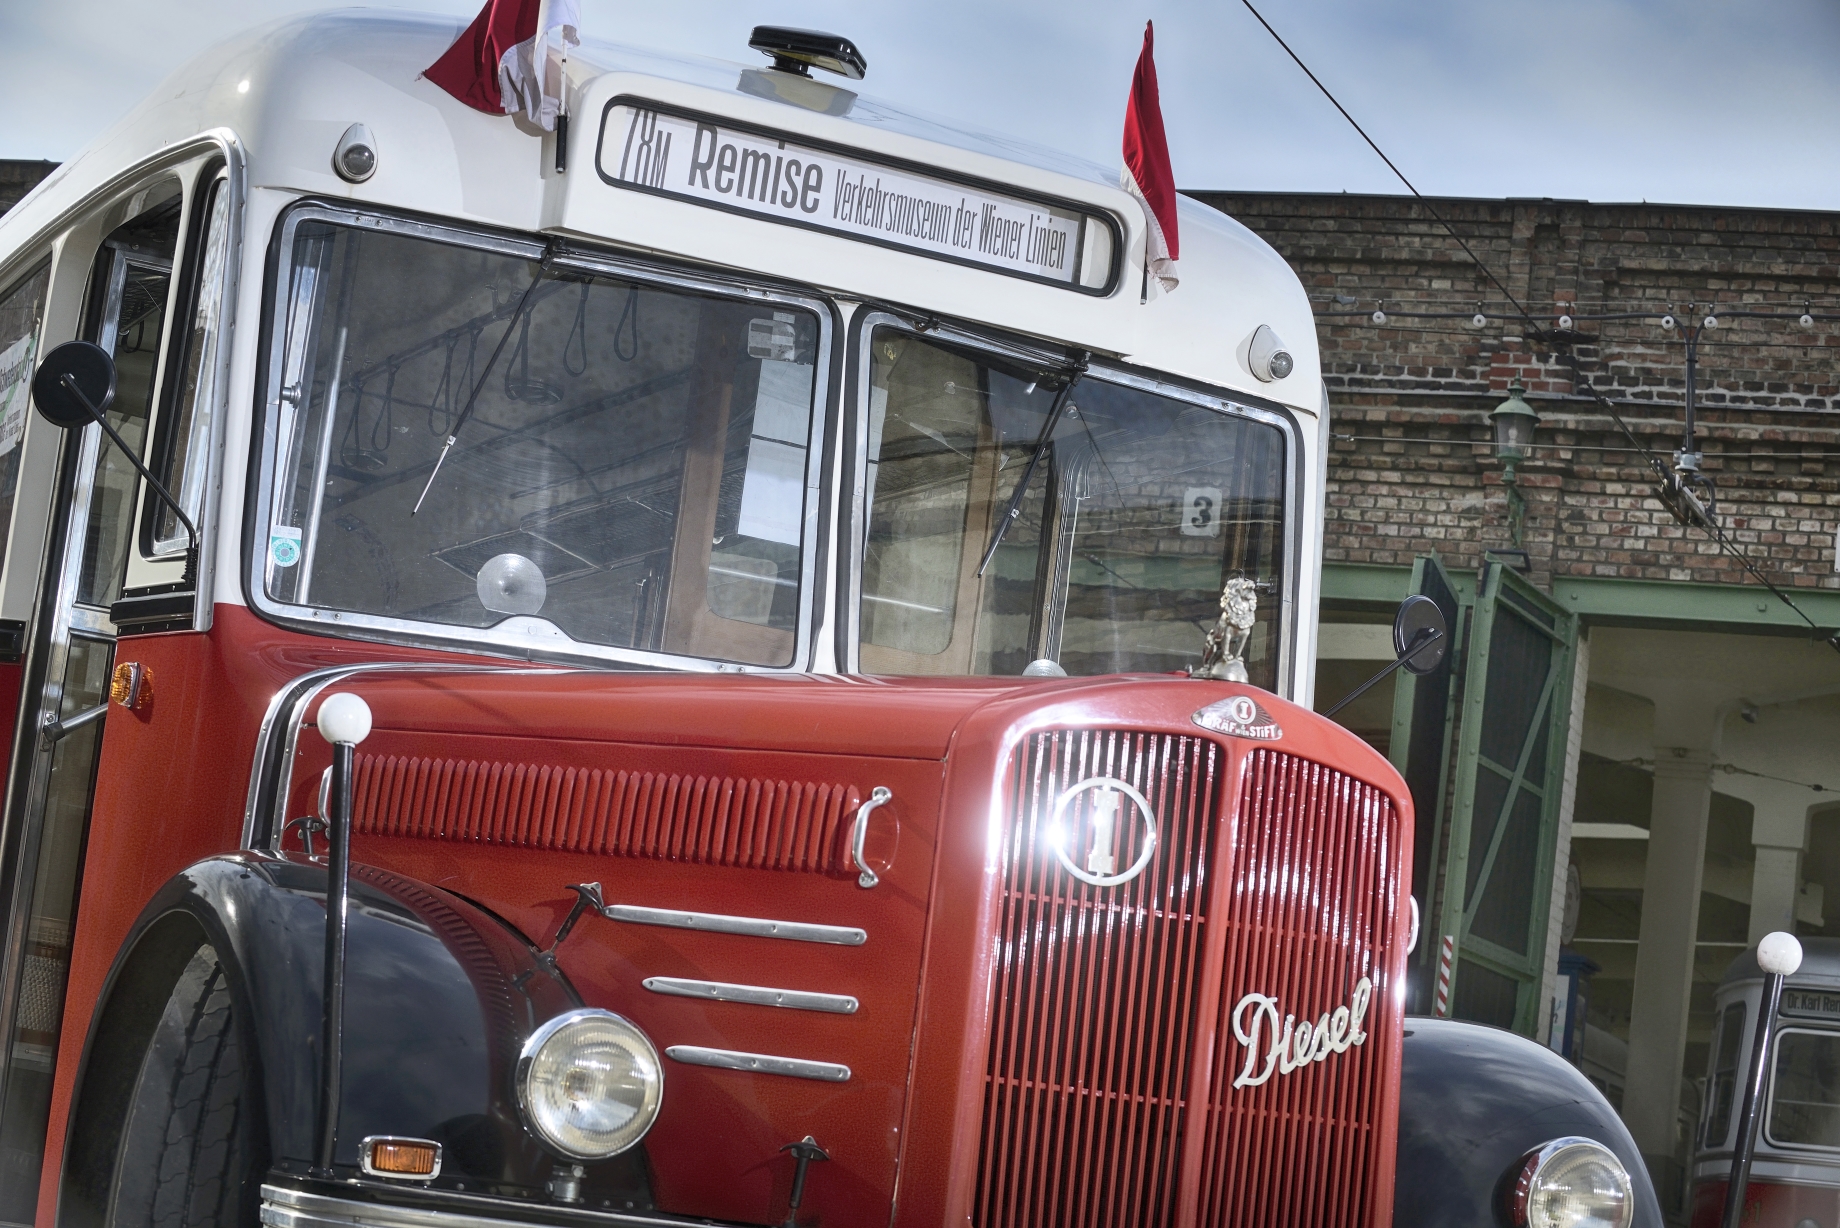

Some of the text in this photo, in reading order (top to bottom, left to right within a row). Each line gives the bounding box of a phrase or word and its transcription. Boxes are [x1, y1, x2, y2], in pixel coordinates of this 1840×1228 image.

[688, 122, 824, 214] Remise
[833, 169, 952, 244] Verkehrsmuseum
[952, 198, 978, 250] der
[979, 203, 1026, 260] Wiener
[1025, 213, 1067, 270] Linien
[1191, 496, 1213, 529] 3
[1232, 977, 1372, 1090] Diesel
[1787, 993, 1800, 1010] Dr.
[1801, 994, 1821, 1012] Karl
